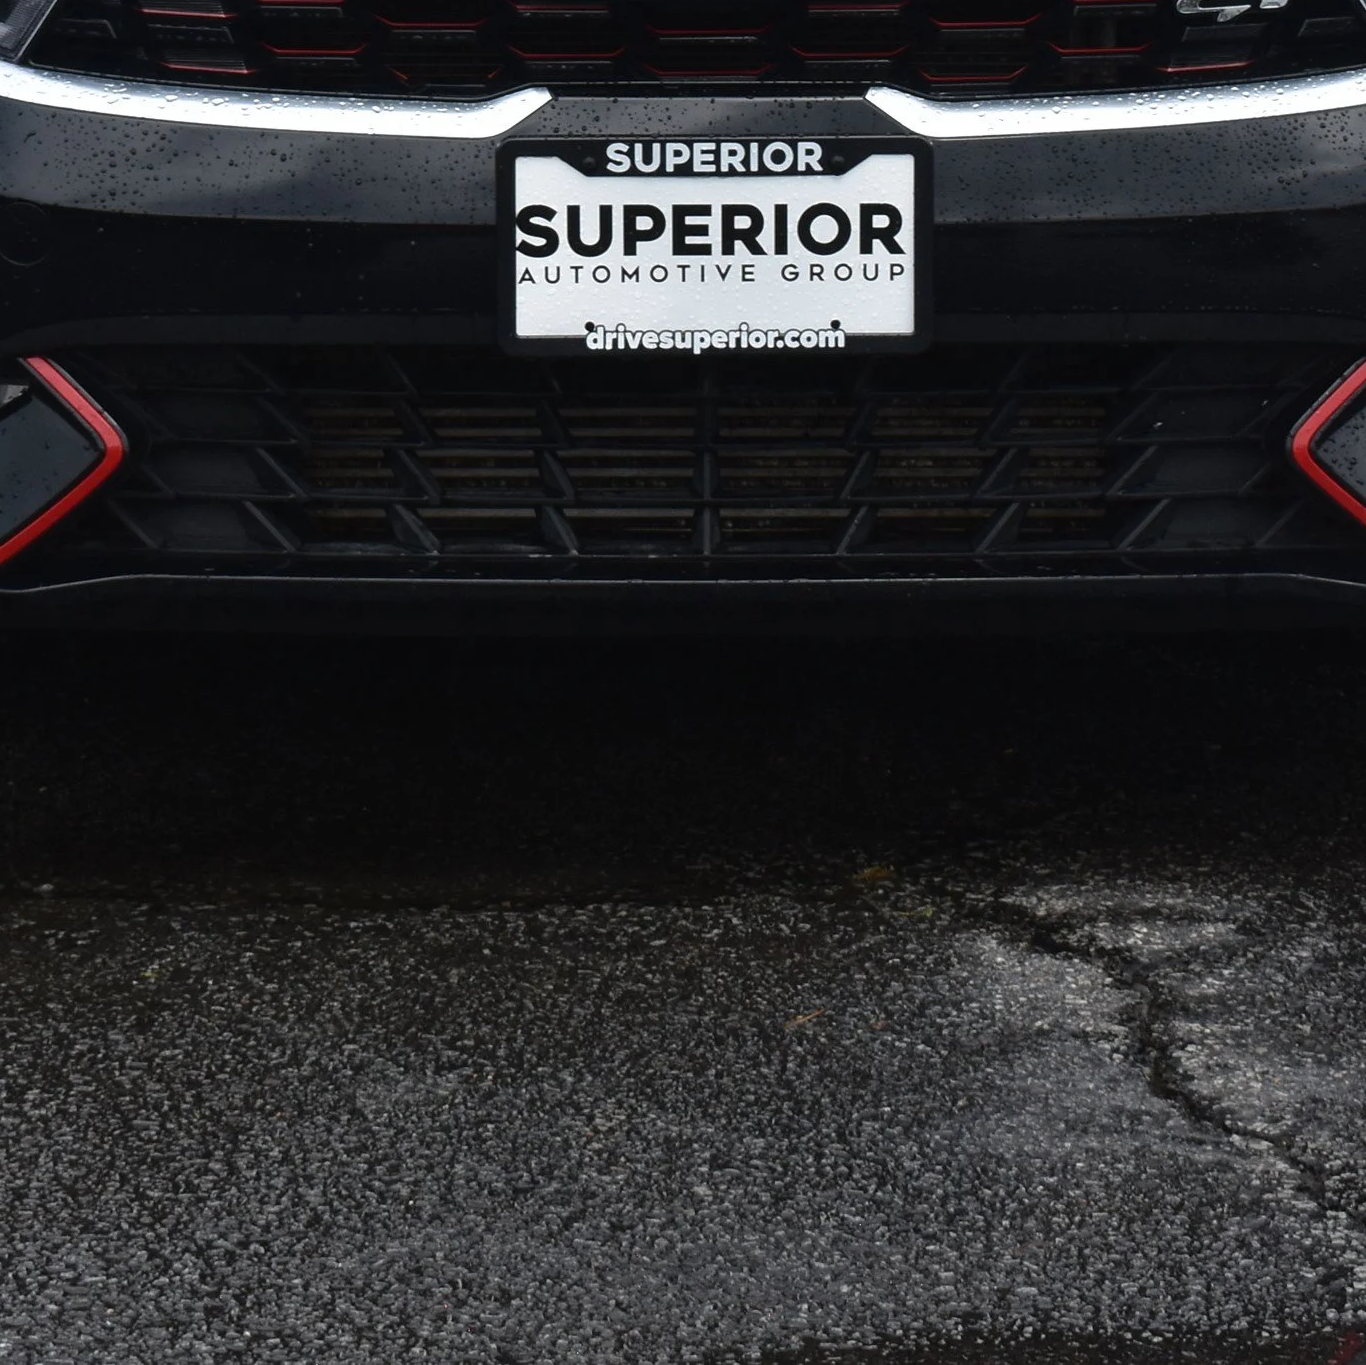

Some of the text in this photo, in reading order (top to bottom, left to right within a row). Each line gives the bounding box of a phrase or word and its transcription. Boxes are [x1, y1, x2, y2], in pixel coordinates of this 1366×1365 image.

[606, 142, 824, 173] SUPERIOR
[515, 203, 907, 258] SUPERIOR
[518, 262, 906, 285] AUTOMOTIVE GROUP
[586, 322, 846, 355] drivesuperior.com
